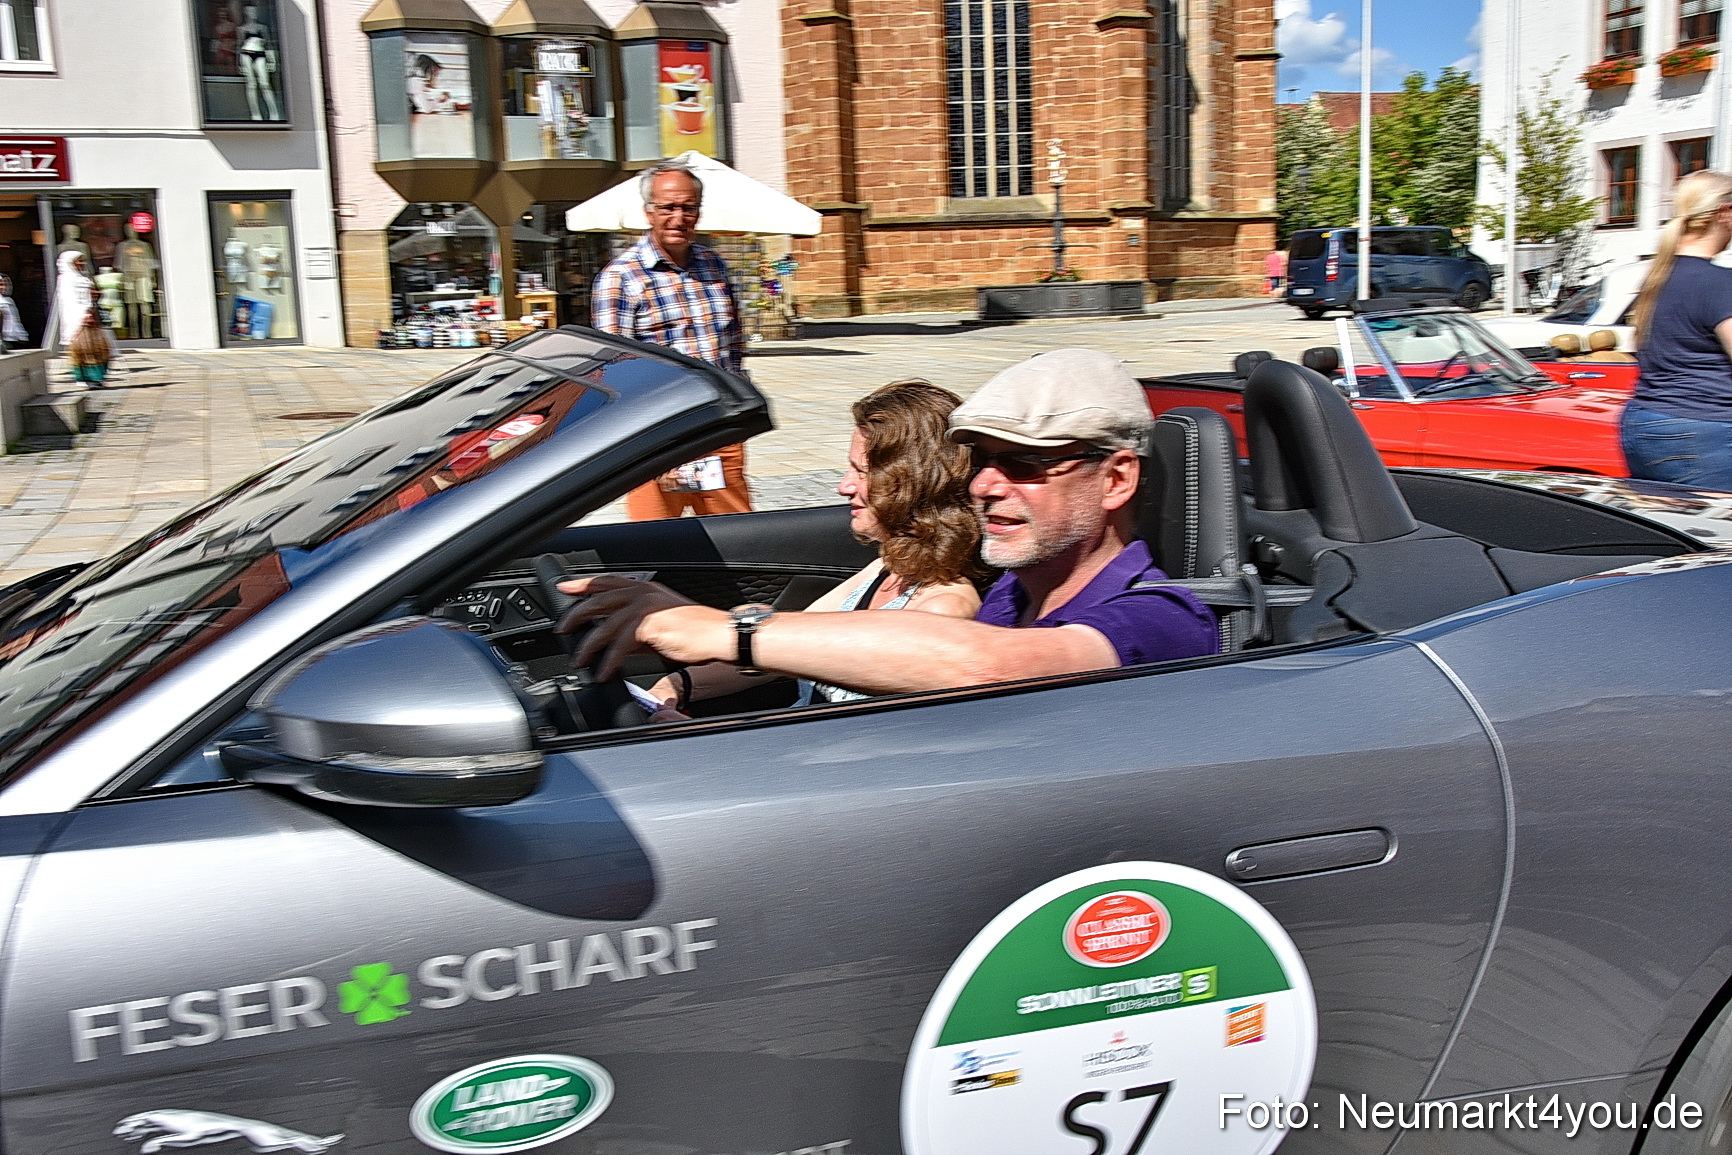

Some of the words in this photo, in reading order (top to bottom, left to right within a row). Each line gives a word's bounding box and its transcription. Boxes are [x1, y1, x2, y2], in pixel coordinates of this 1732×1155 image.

[0, 150, 58, 172] atz
[69, 976, 331, 1062] FESER
[418, 917, 718, 1009] SCHARF
[1186, 973, 1211, 995] S
[1062, 1081, 1172, 1155] S7
